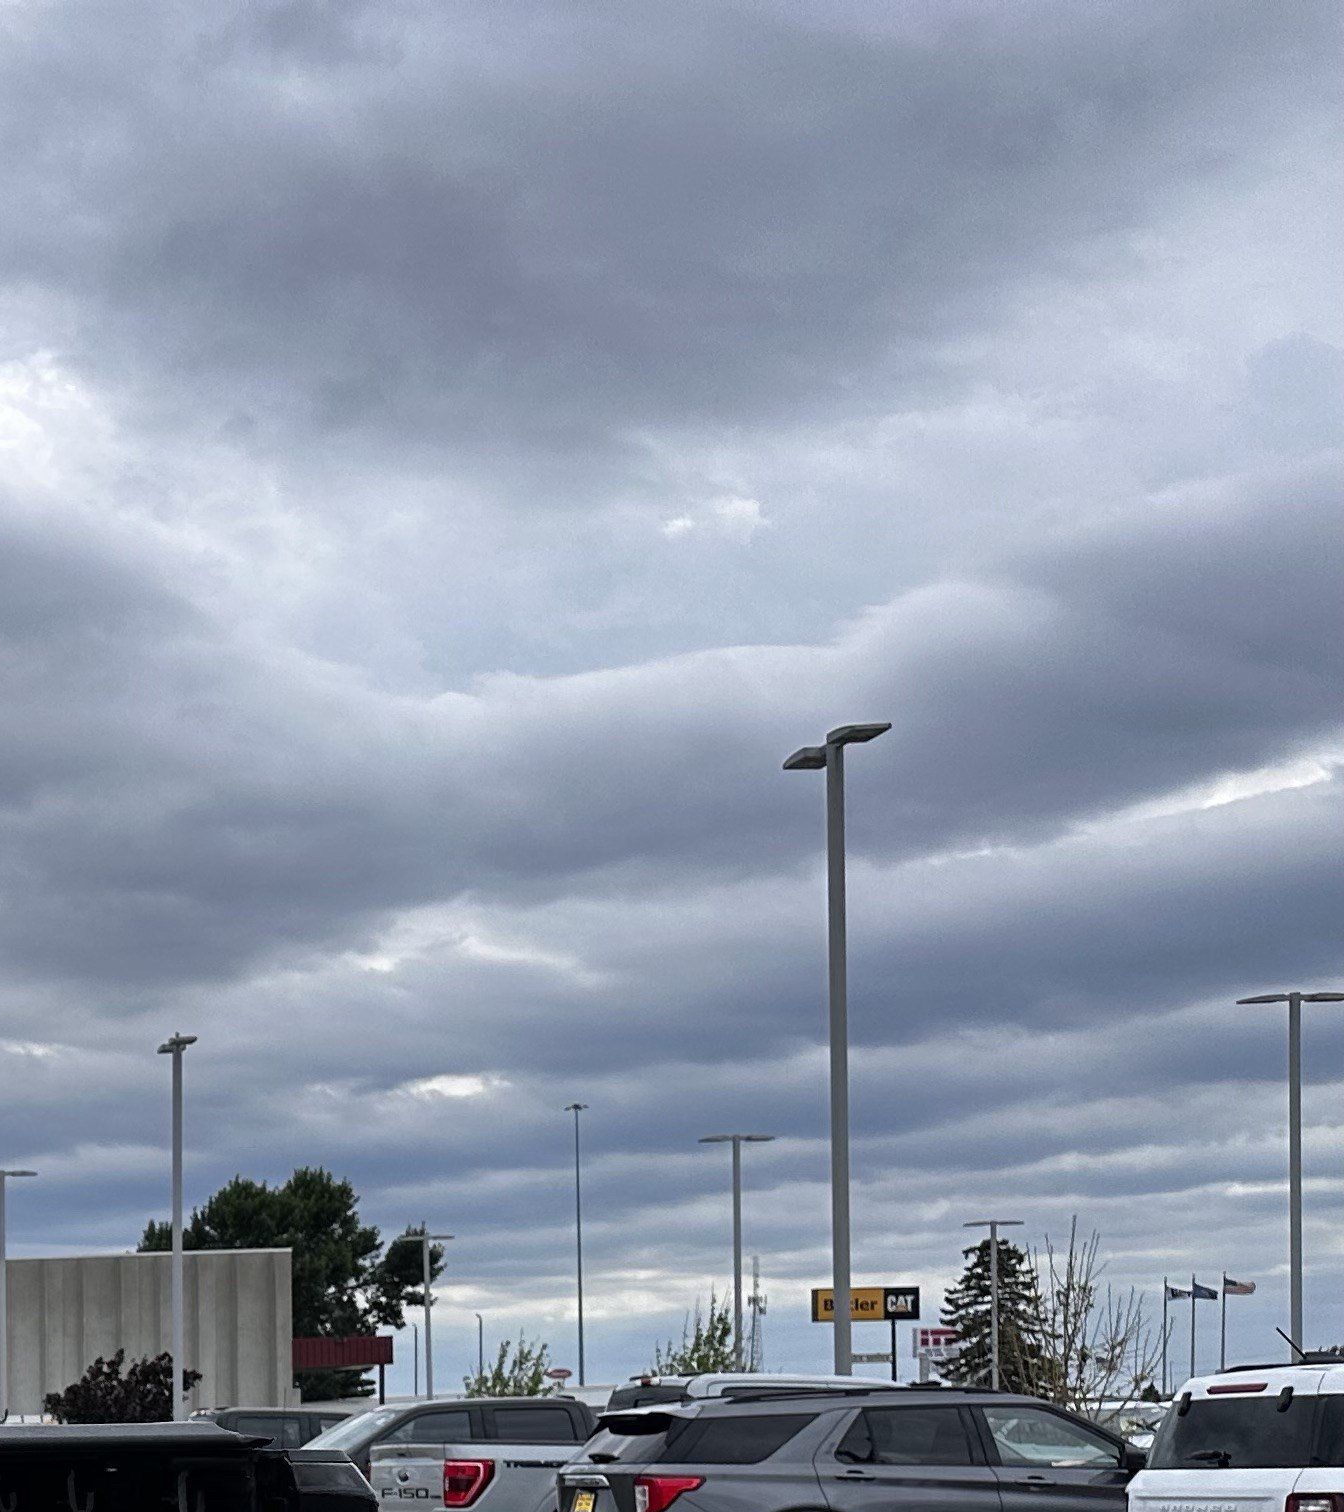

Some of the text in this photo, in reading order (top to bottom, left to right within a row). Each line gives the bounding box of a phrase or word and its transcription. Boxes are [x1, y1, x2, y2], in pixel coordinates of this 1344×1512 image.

[823, 1294, 916, 1313] Bler CAT
[382, 1488, 429, 1499] F-150
